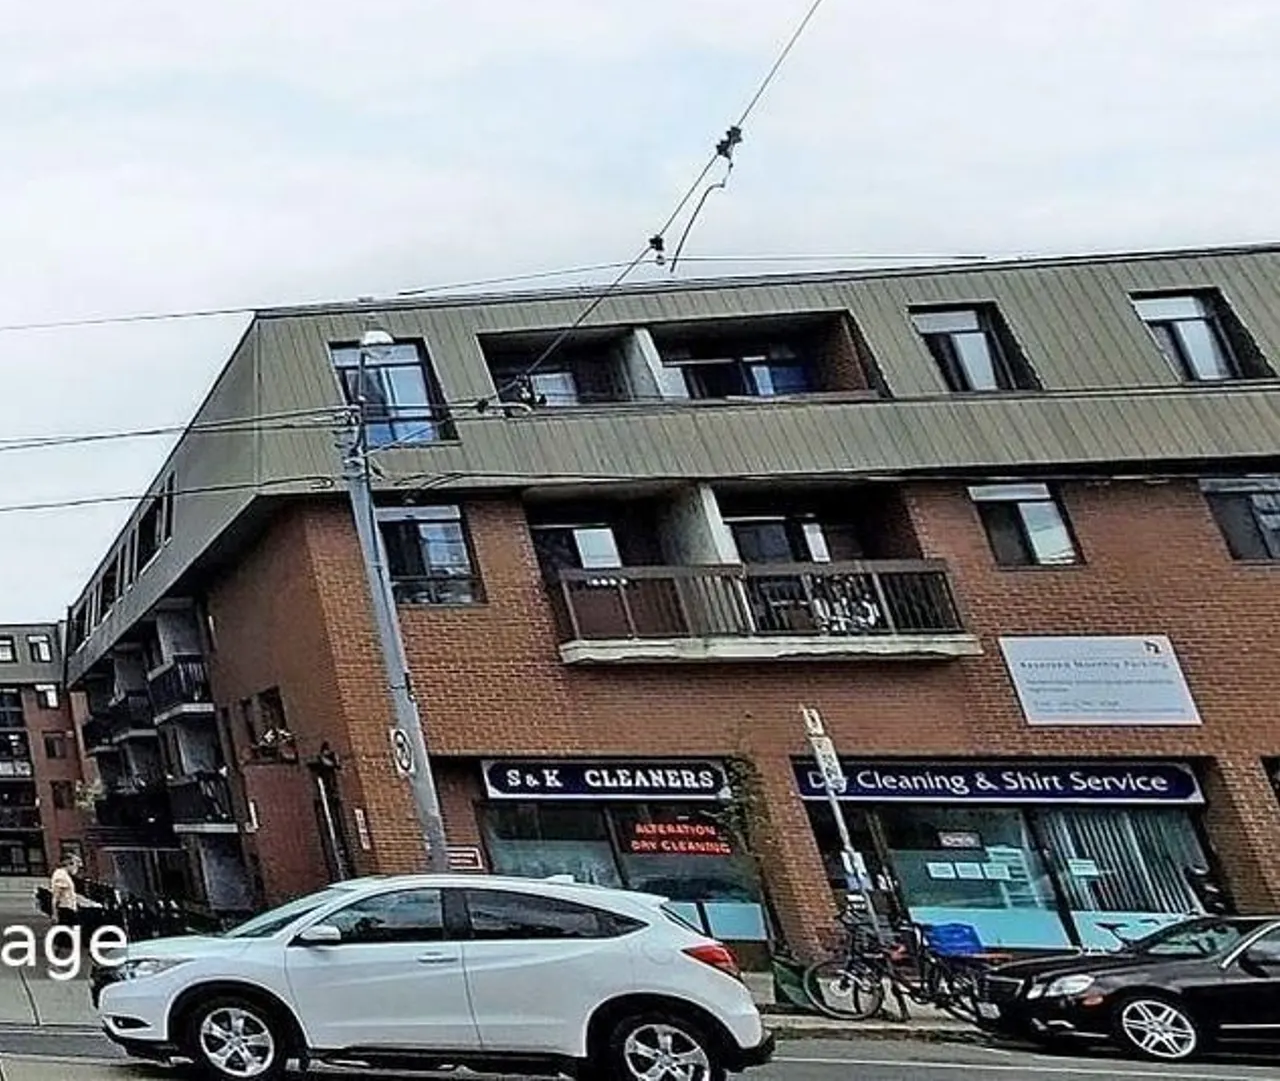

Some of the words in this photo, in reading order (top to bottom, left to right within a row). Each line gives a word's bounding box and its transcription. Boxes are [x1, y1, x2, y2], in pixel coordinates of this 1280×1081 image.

[506, 769, 522, 787] S
[525, 774, 540, 786] &
[544, 769, 564, 788] K
[584, 769, 715, 789] CLEANERS
[857, 770, 971, 795] Cleaning
[974, 771, 1000, 791] &
[1005, 770, 1064, 791] Shirt
[1073, 772, 1169, 792] Service
[631, 839, 657, 852] DRY
[661, 840, 731, 854] CLEANING
